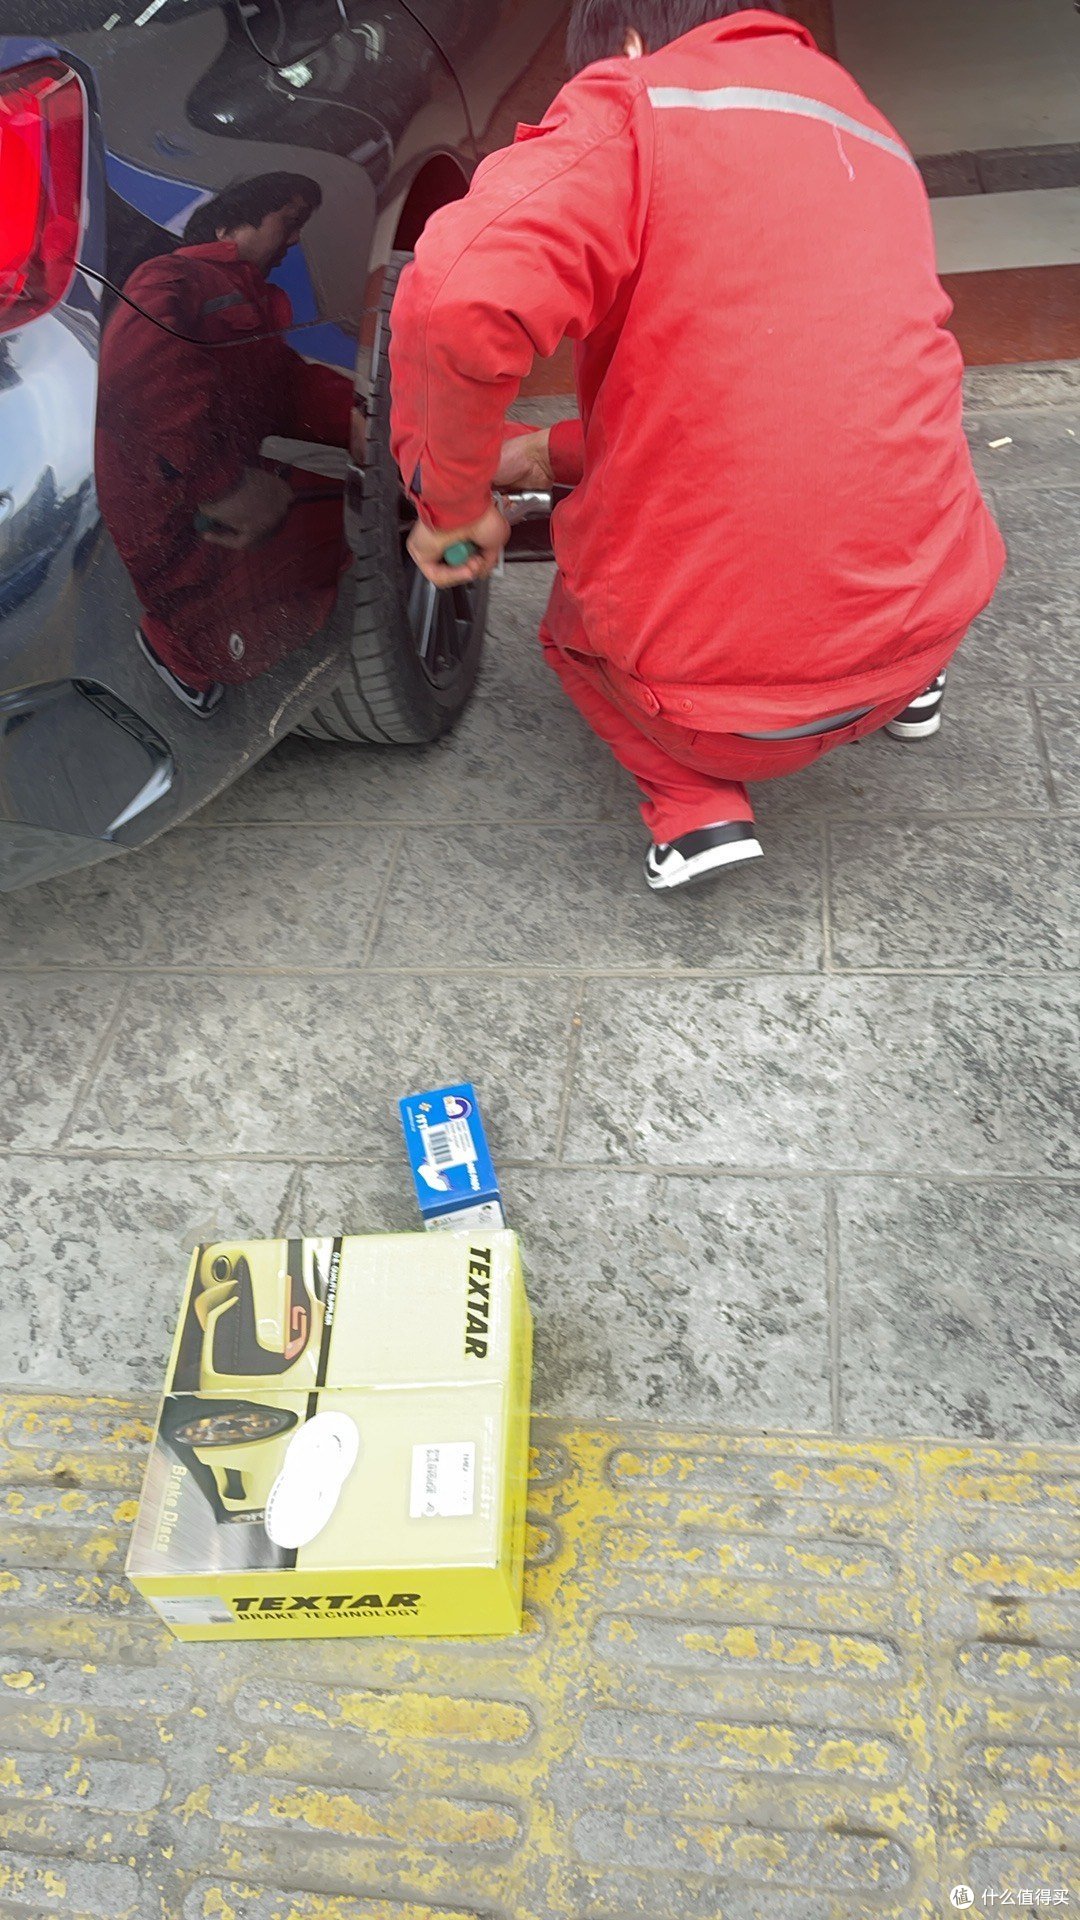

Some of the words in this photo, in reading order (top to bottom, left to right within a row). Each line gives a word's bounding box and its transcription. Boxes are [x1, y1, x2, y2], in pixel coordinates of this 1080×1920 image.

[464, 1247, 491, 1359] TEXTAR
[165, 1464, 188, 1507] Brake
[155, 1511, 179, 1552] Discs
[232, 1593, 422, 1612] TEXTAR
[238, 1612, 295, 1621] BRAKE
[304, 1609, 421, 1620] TECHNOLOGY
